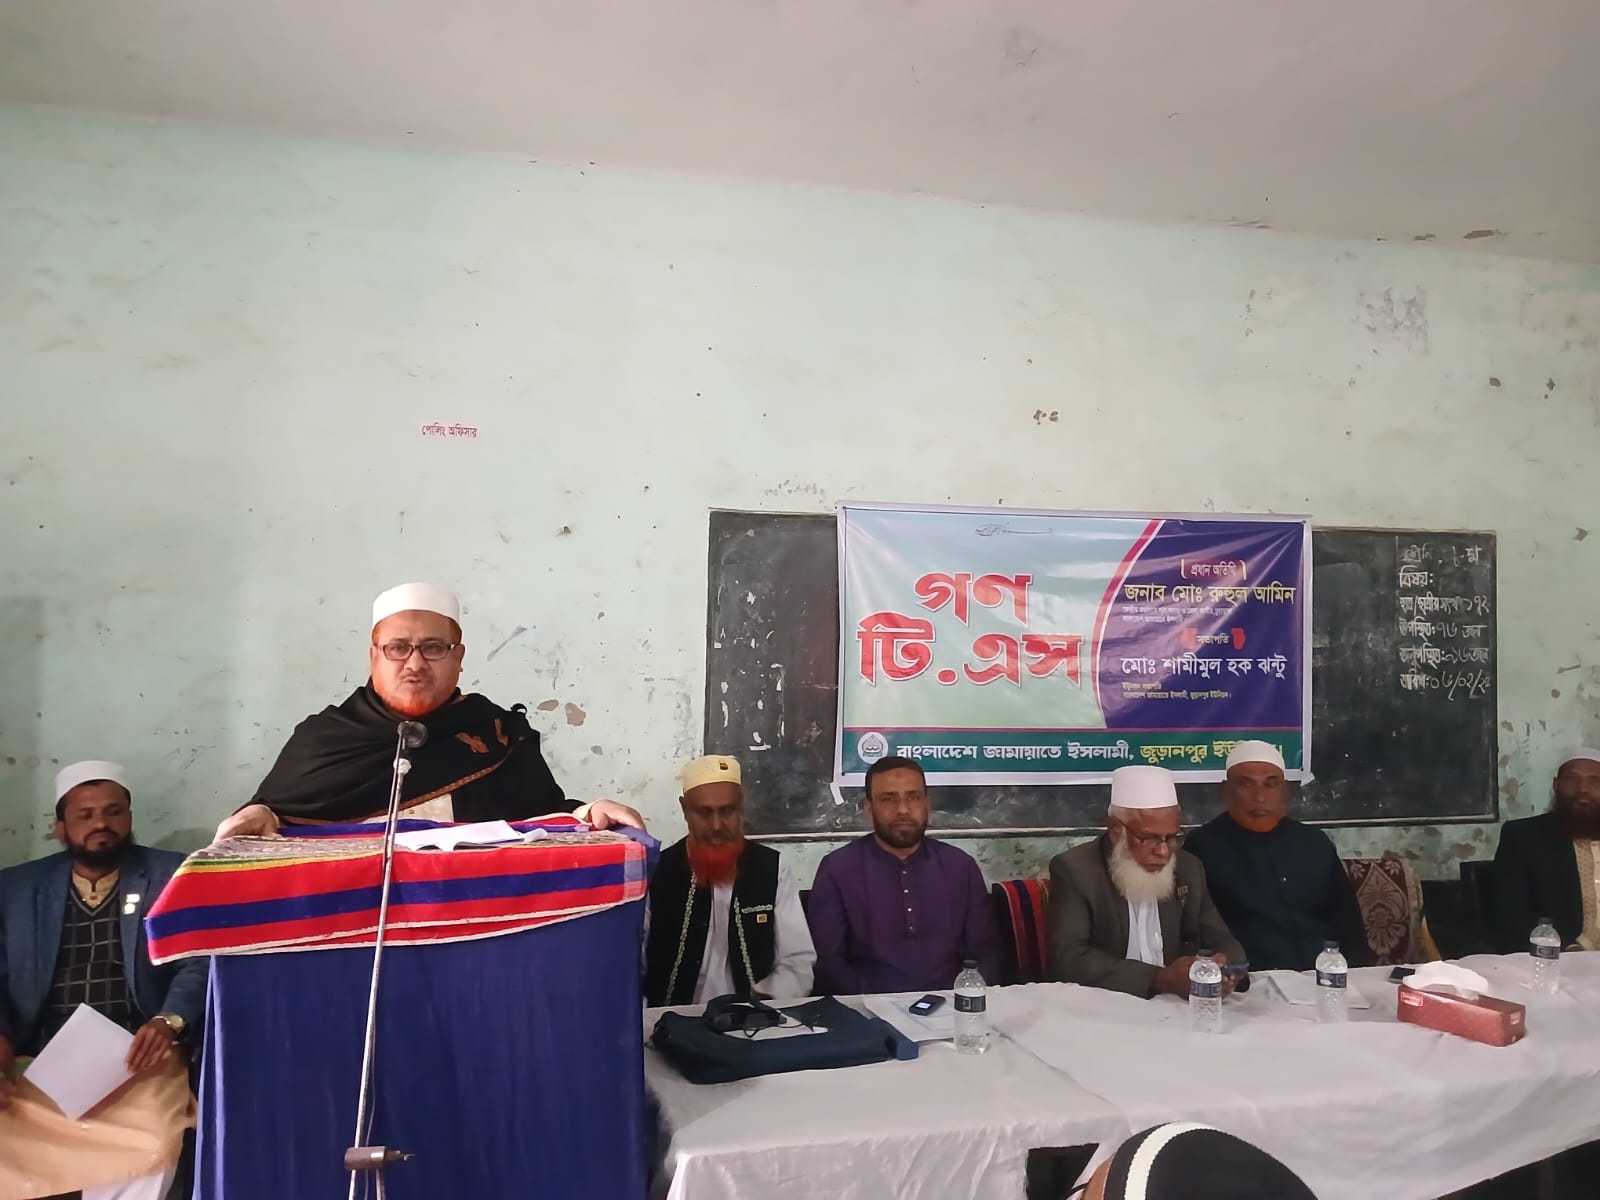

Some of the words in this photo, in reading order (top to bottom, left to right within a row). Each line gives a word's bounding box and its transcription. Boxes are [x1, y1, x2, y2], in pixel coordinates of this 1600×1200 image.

[421, 421, 447, 437] পোলিং
[448, 423, 478, 438] অফিসার
[1190, 563, 1211, 577] প্রধান
[914, 572, 1033, 628] গণ
[1124, 583, 1167, 602] জনাব
[1171, 584, 1203, 604] মোঃ
[1207, 585, 1249, 607] রুহুল
[1253, 580, 1297, 605] আমিন
[1120, 657, 1156, 675] মোঃ
[1162, 652, 1223, 679] শামীমুল
[1226, 657, 1254, 677] হক
[1256, 652, 1288, 680] ঝন্টু
[896, 744, 978, 760] বাংলাদেশ
[983, 745, 1063, 761] জামায়াতে
[1067, 740, 1134, 761] ইসলামী,
[1139, 744, 1209, 764] জুড়ানপুর
